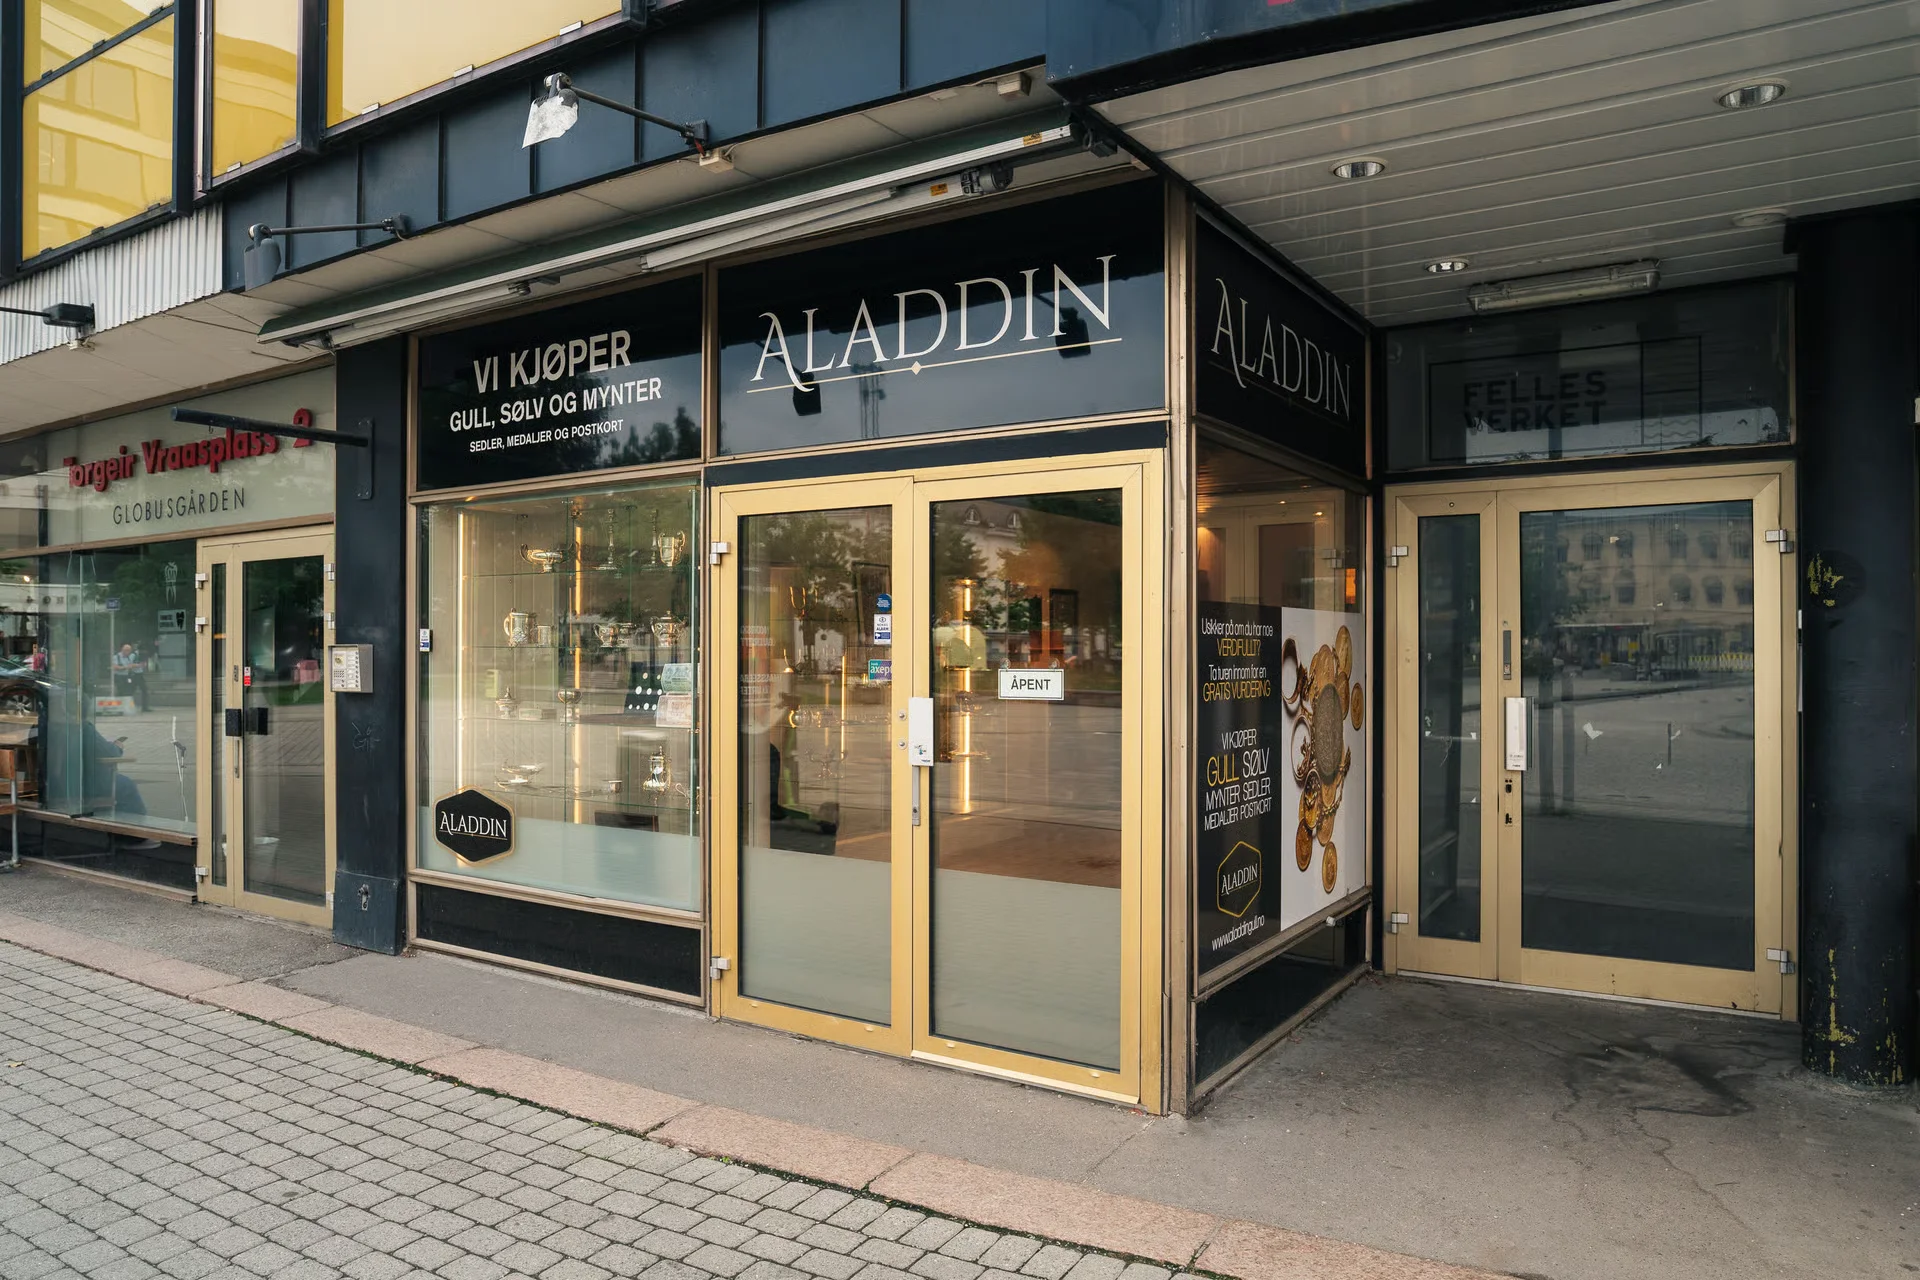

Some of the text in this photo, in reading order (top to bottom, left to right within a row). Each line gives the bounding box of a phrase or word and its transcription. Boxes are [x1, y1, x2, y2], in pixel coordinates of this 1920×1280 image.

[750, 254, 1117, 392] ALADDIN
[473, 329, 631, 394] VI KJØPER
[1210, 278, 1351, 421] ALADDIN
[450, 377, 662, 432] GULL, SØLV OG MYNTER
[1464, 370, 1606, 407] FELLES
[63, 407, 314, 493] Torgeir Vraasplass 2
[469, 419, 624, 453] SEDLER, MEDALJER OG POSTKORT
[113, 487, 245, 525] GLOBUSGÅRDEN
[1201, 617, 1274, 638] Usikker på om du har noe
[1010, 674, 1051, 691] ÅPENT
[1208, 663, 1267, 681] Ta turen innom for en
[1203, 679, 1271, 702] GRATIS VURDERING
[1221, 728, 1257, 750] VI KJØPER
[1207, 747, 1270, 787] GULL SØLV
[1206, 776, 1271, 812] MYNTER SEDLER
[440, 811, 507, 838] ALADDIN
[1204, 796, 1272, 831] MEDALJER POSTKORT
[1221, 863, 1258, 895] ALADDIN
